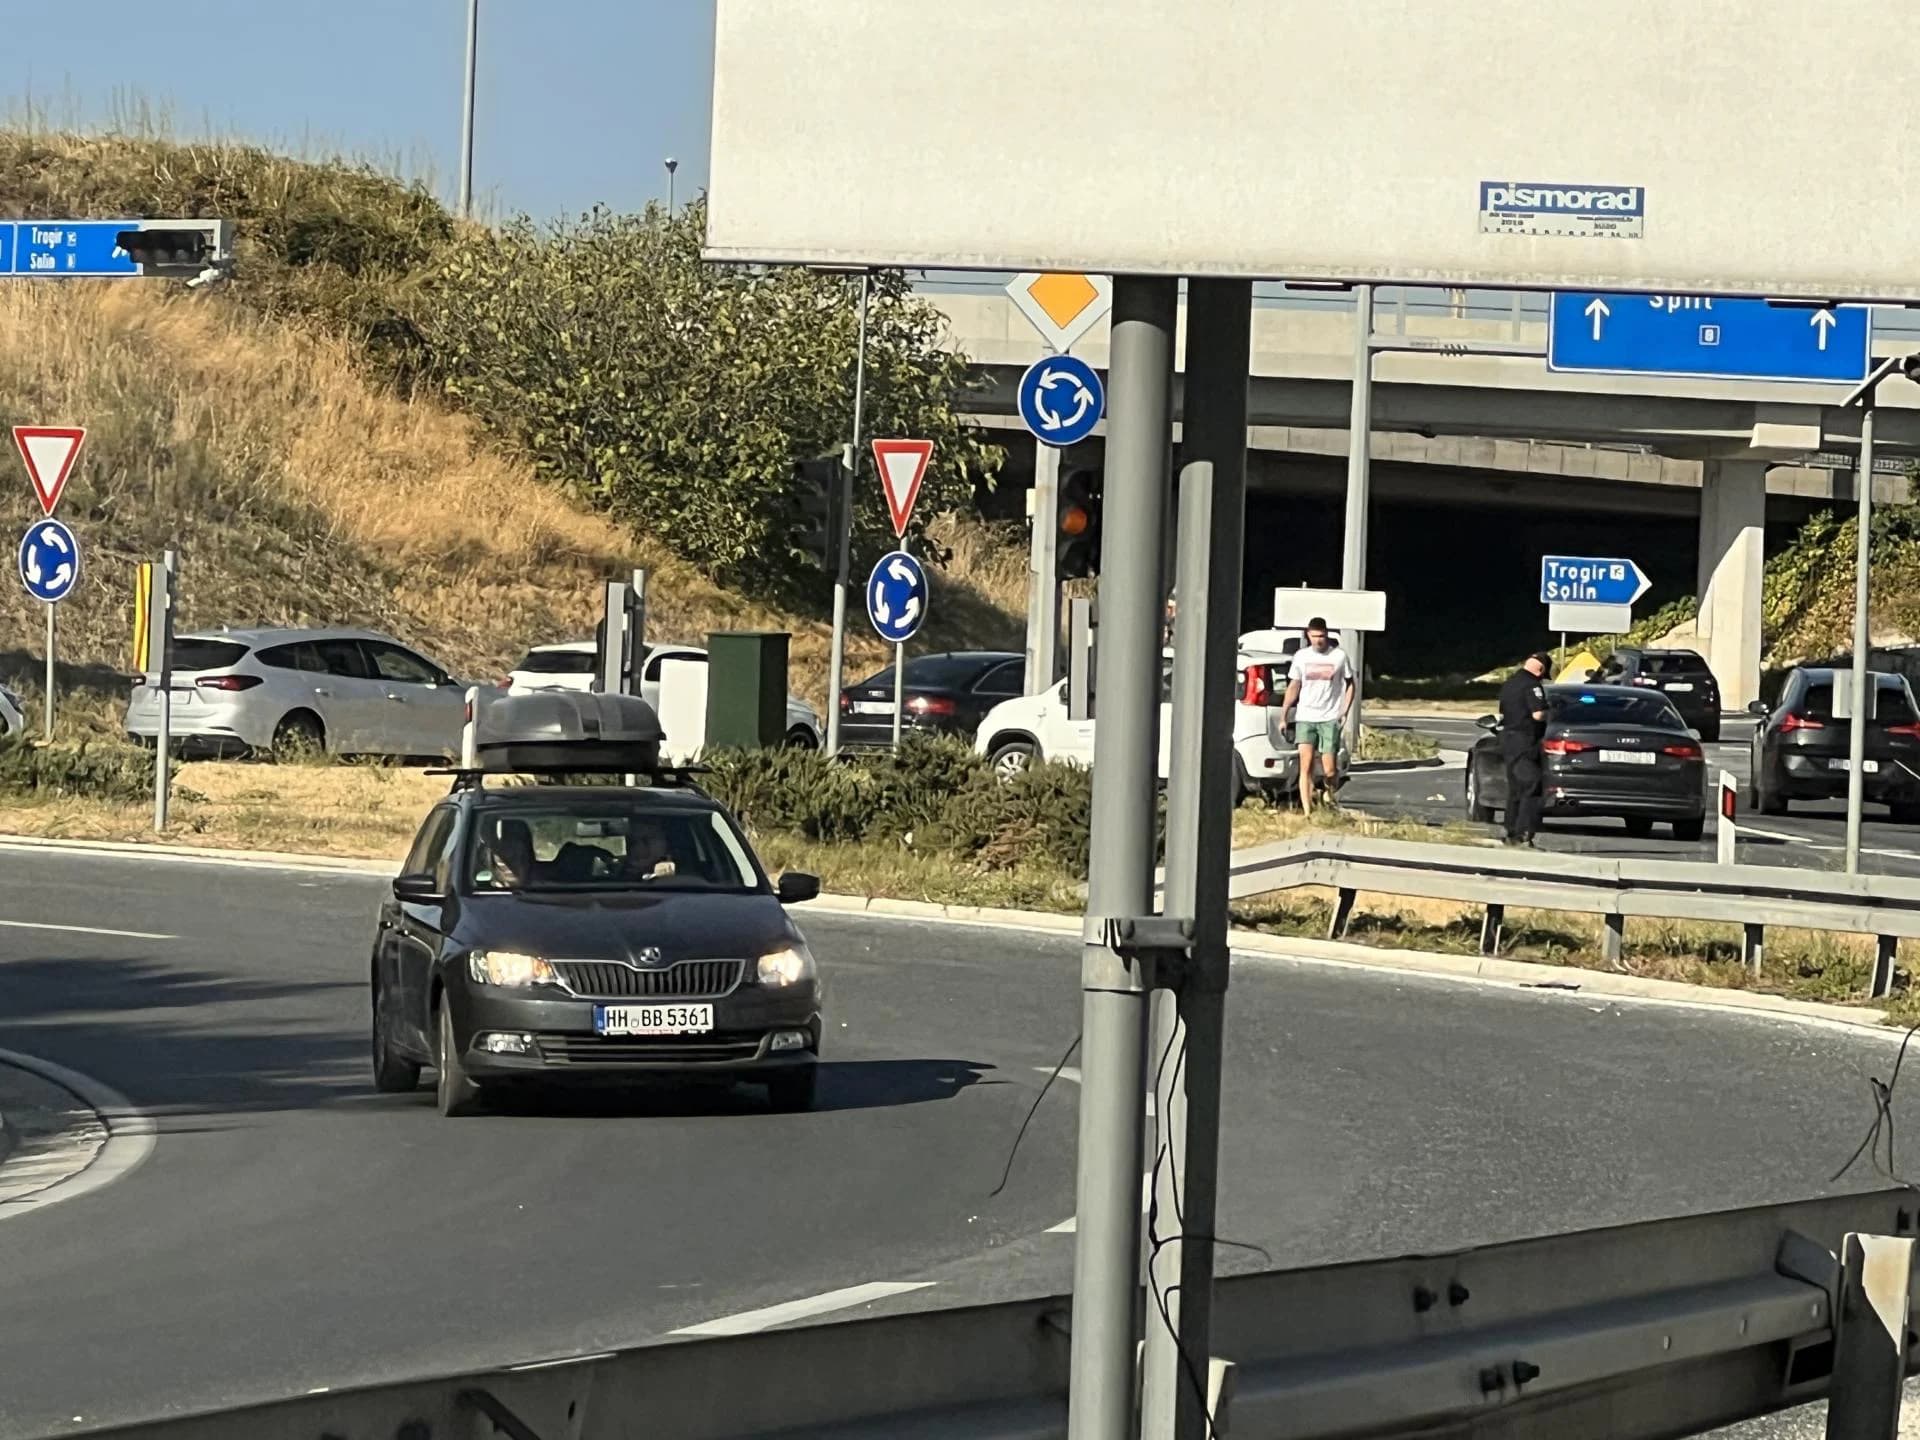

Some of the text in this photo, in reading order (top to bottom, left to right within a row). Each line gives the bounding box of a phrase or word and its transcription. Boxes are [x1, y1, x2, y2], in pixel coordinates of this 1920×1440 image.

[1487, 182, 1637, 213] pismorad
[1548, 562, 1606, 584] Trogir
[1546, 581, 1597, 600] Solin
[606, 1007, 710, 1028] HH BB 5361
